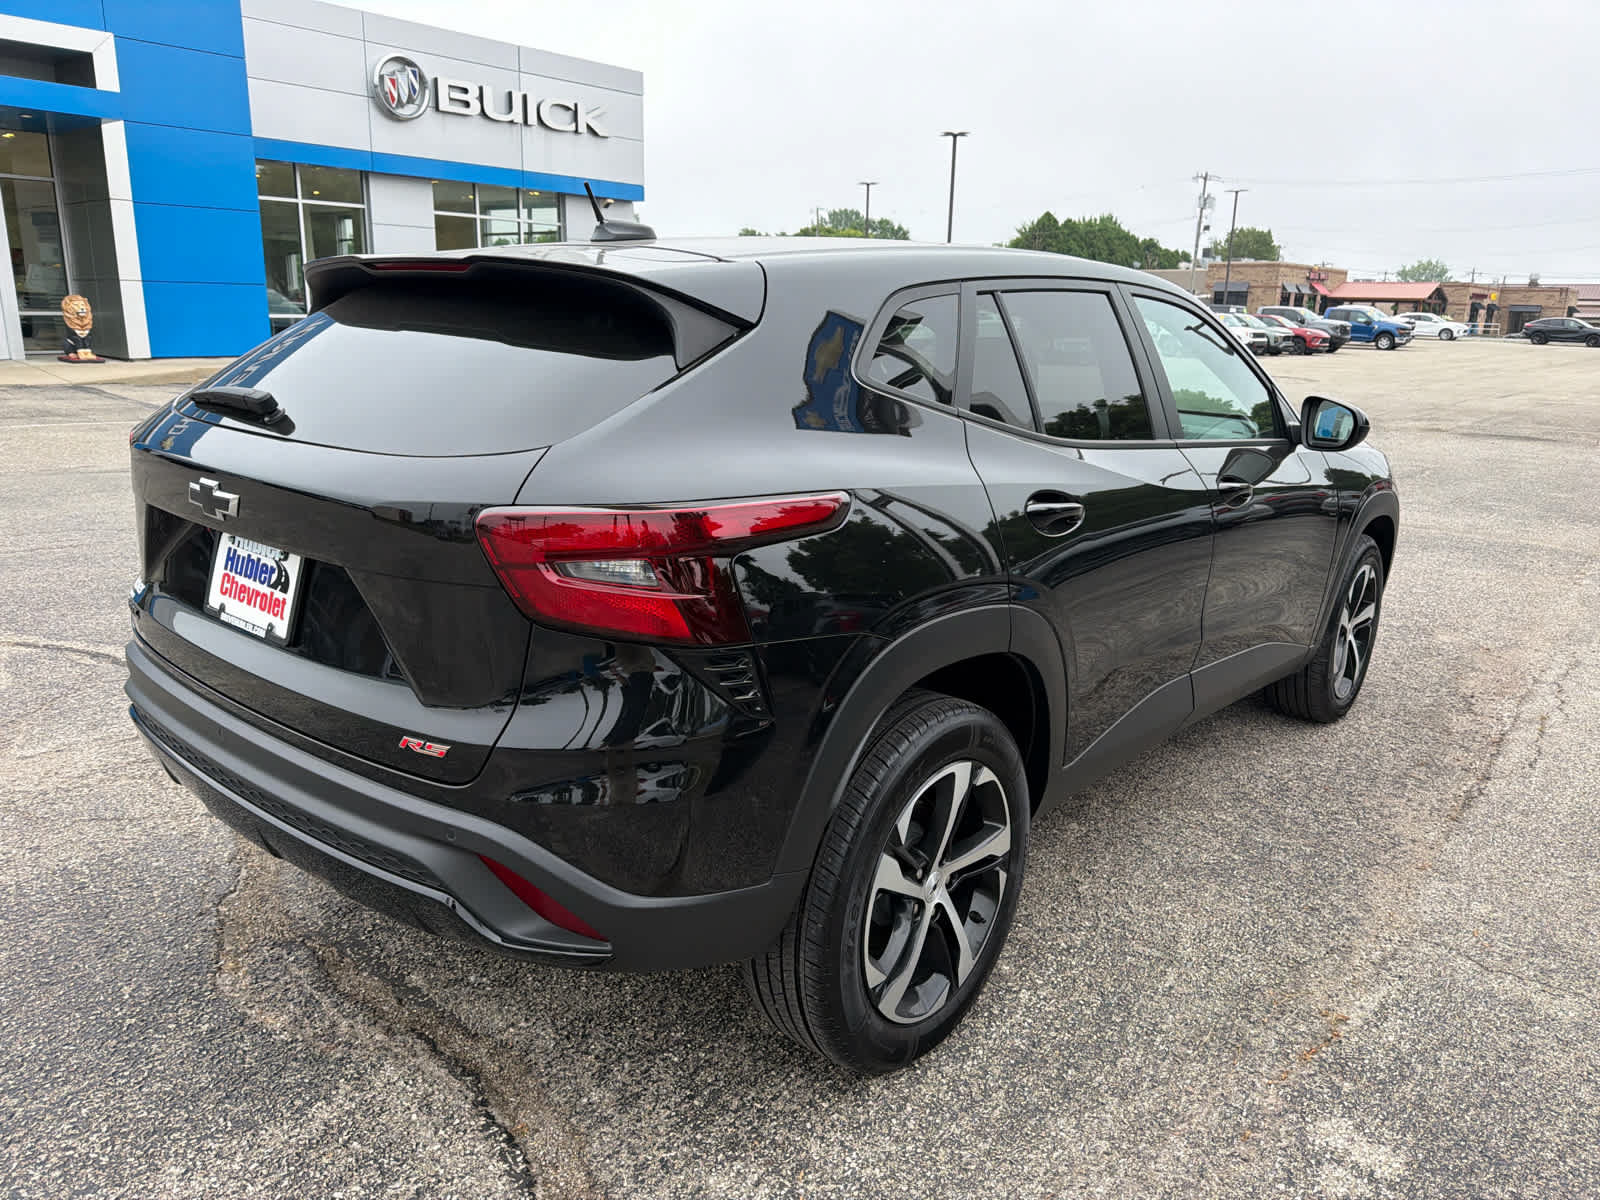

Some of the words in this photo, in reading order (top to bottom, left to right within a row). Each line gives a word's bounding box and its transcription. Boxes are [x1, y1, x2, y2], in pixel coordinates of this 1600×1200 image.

[435, 76, 608, 138] BUICK
[224, 546, 276, 587] Hubler
[220, 572, 287, 621] Chevrolet
[399, 736, 451, 758] RS
